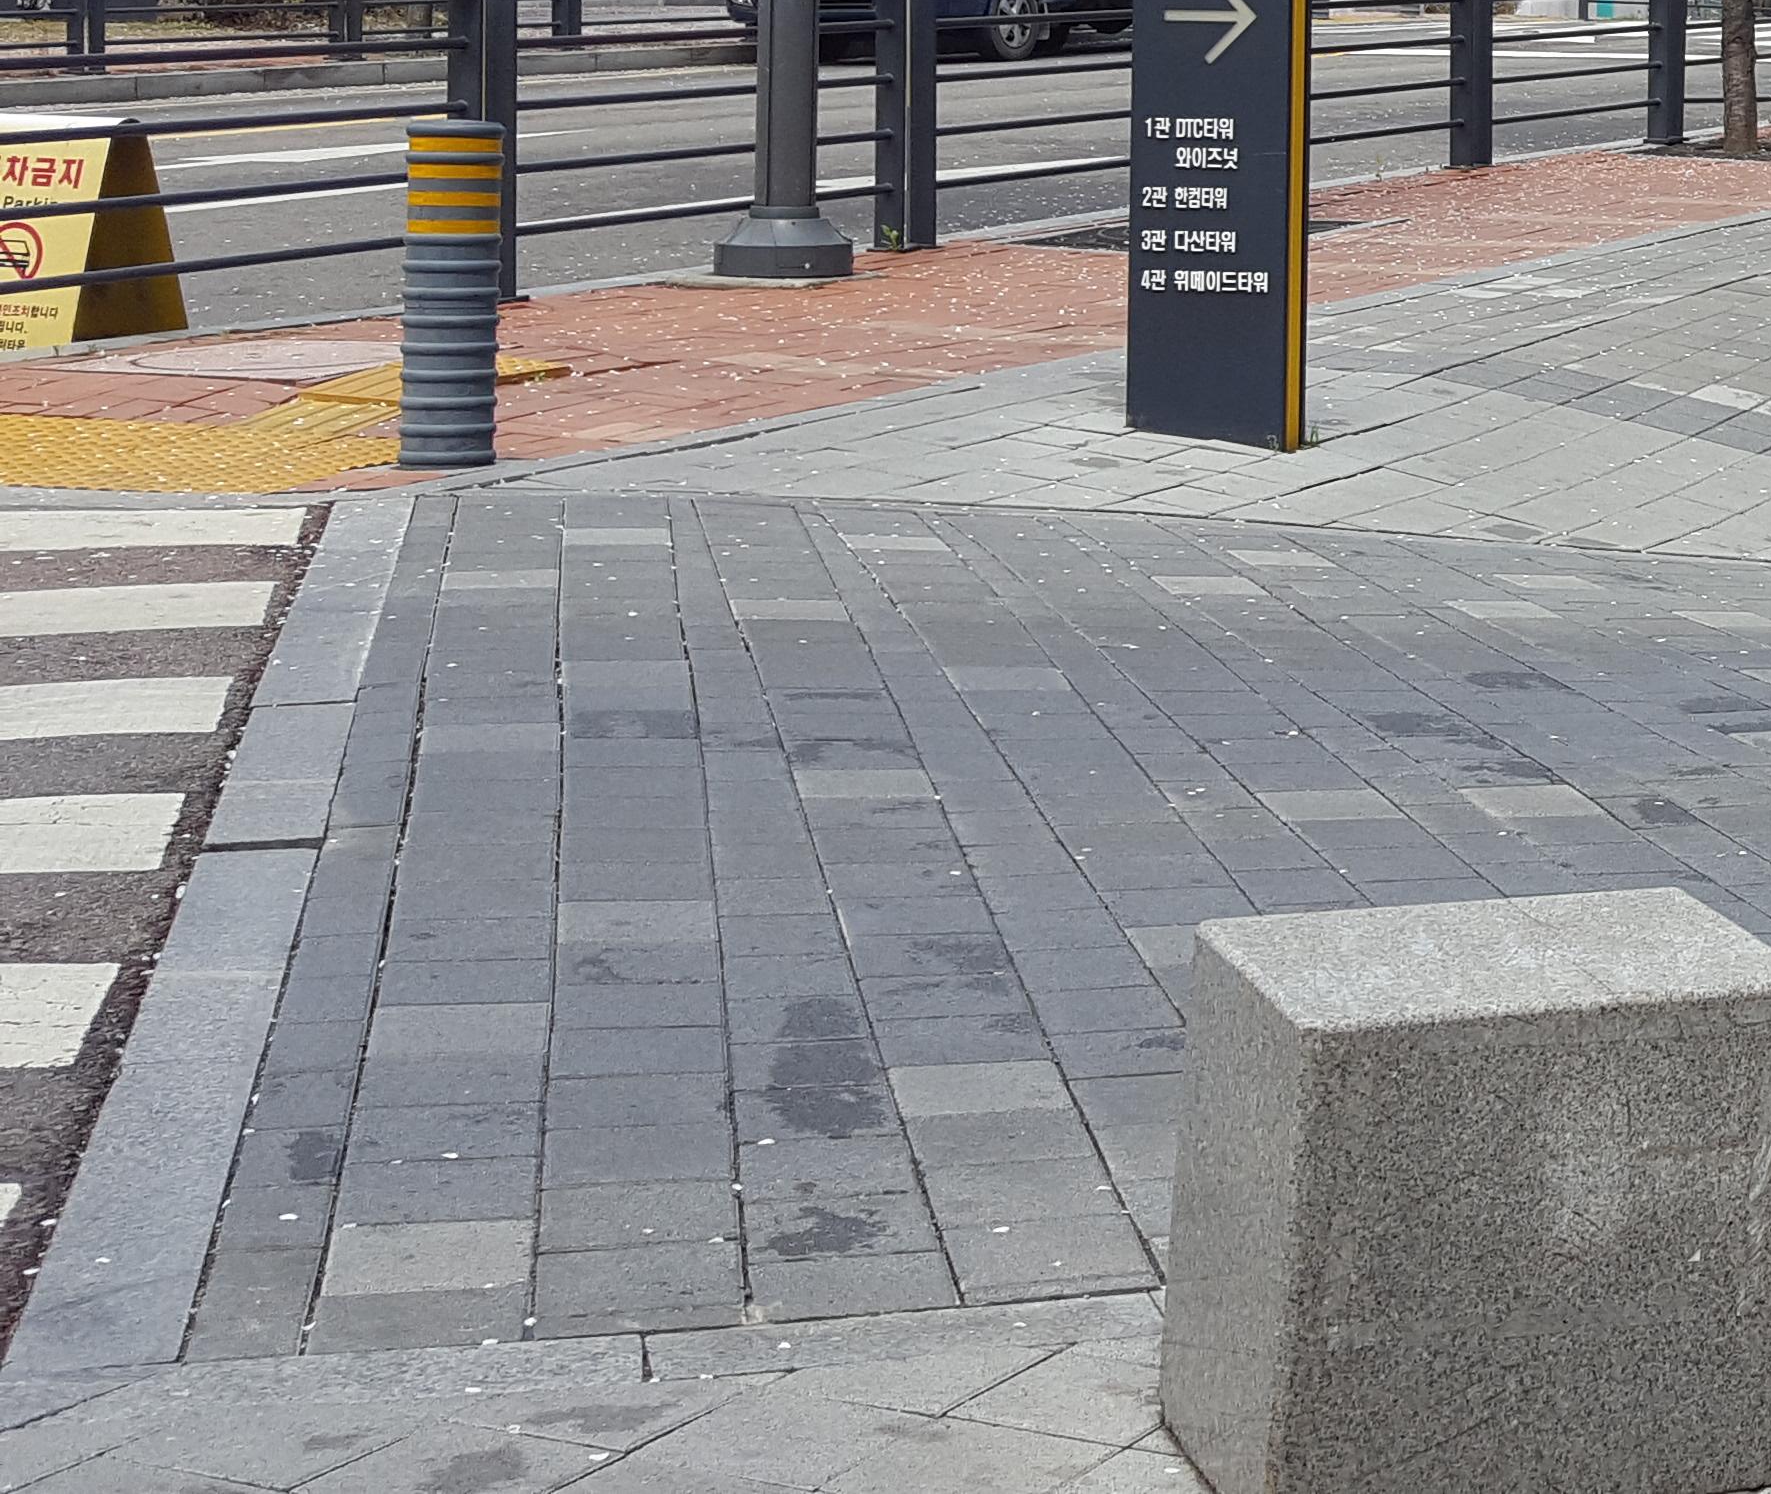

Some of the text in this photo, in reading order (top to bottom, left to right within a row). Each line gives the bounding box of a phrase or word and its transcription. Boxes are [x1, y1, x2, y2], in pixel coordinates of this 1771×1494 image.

[1145, 117, 1234, 139] 1관 DTC타워
[1175, 147, 1238, 169] 와이즈넛
[0, 155, 84, 189] 차금지
[1142, 186, 1228, 209] 2관 한컴타워
[1141, 230, 1236, 252] 3관 다산타워
[1141, 269, 1268, 293] 4관 위메이드타워
[0, 305, 58, 319] 인조치합니다
